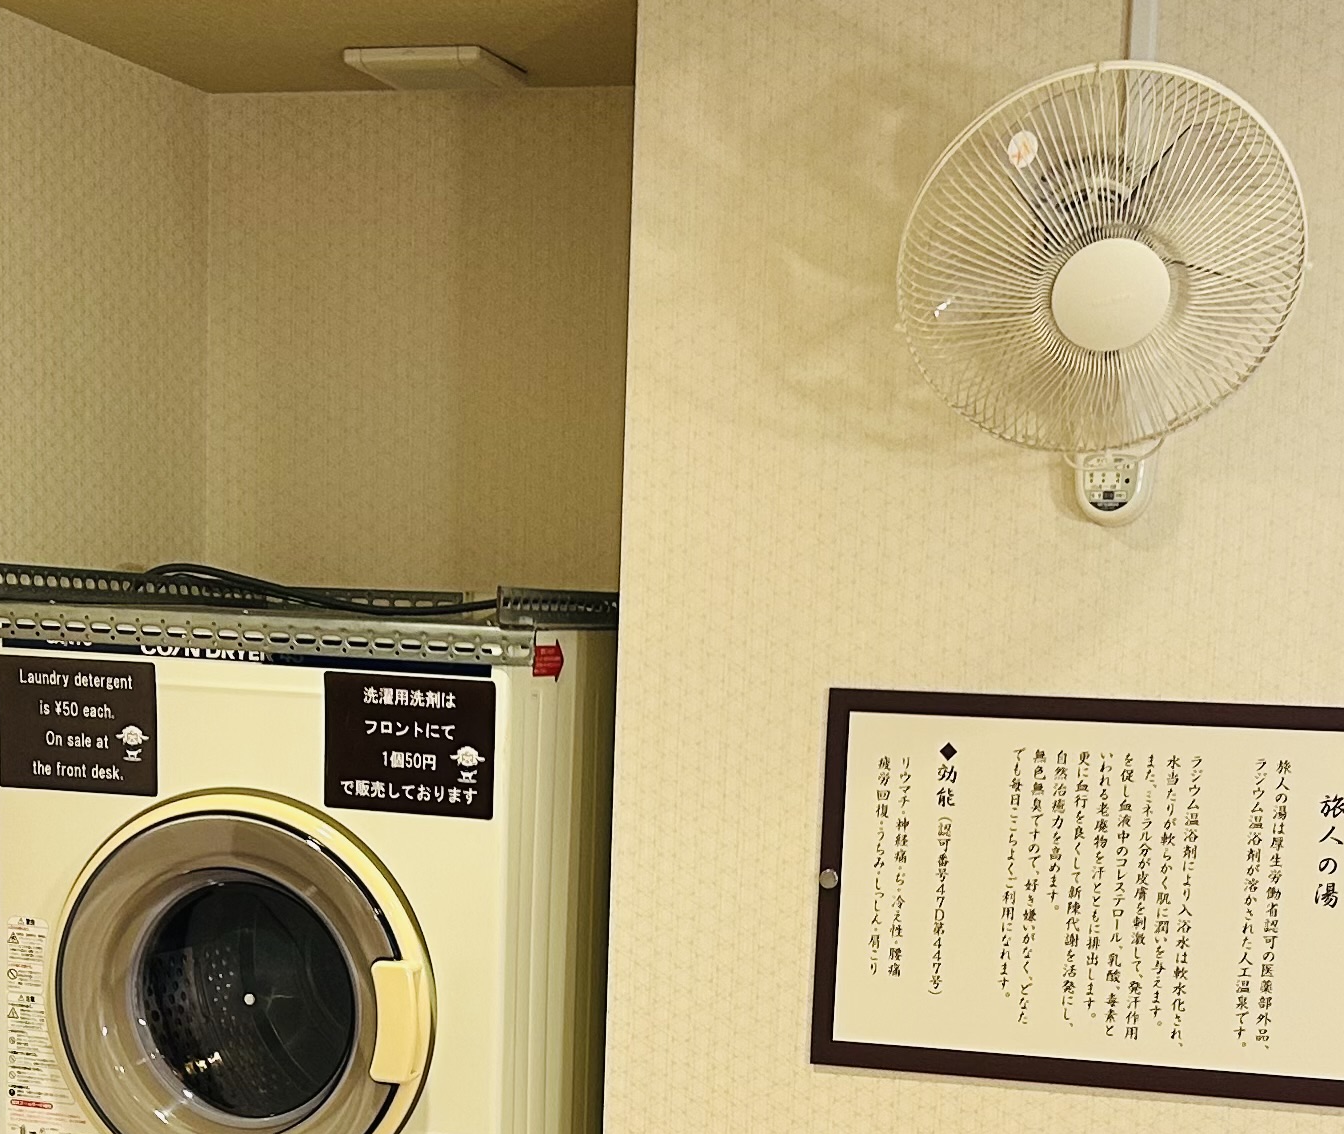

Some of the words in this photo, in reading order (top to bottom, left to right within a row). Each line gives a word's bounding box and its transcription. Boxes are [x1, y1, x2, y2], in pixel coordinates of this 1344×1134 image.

[19, 668, 69, 688] Laundry
[74, 671, 133, 691] detergent
[363, 686, 457, 709] 洗濯用洗剤は
[39, 700, 51, 715] is
[54, 700, 79, 717] ¥50
[82, 704, 115, 720] each.
[45, 730, 63, 747] On
[66, 732, 92, 748] sale
[96, 735, 109, 749] at
[364, 719, 456, 741] フロントにて
[32, 760, 52, 776] the
[56, 761, 87, 778] front
[91, 764, 124, 781] desk.
[382, 750, 437, 771] 1個50円
[340, 779, 478, 805] で販売しております
[936, 763, 958, 808] 効能
[1046, 750, 1068, 911] 自然治癒力を高めます。
